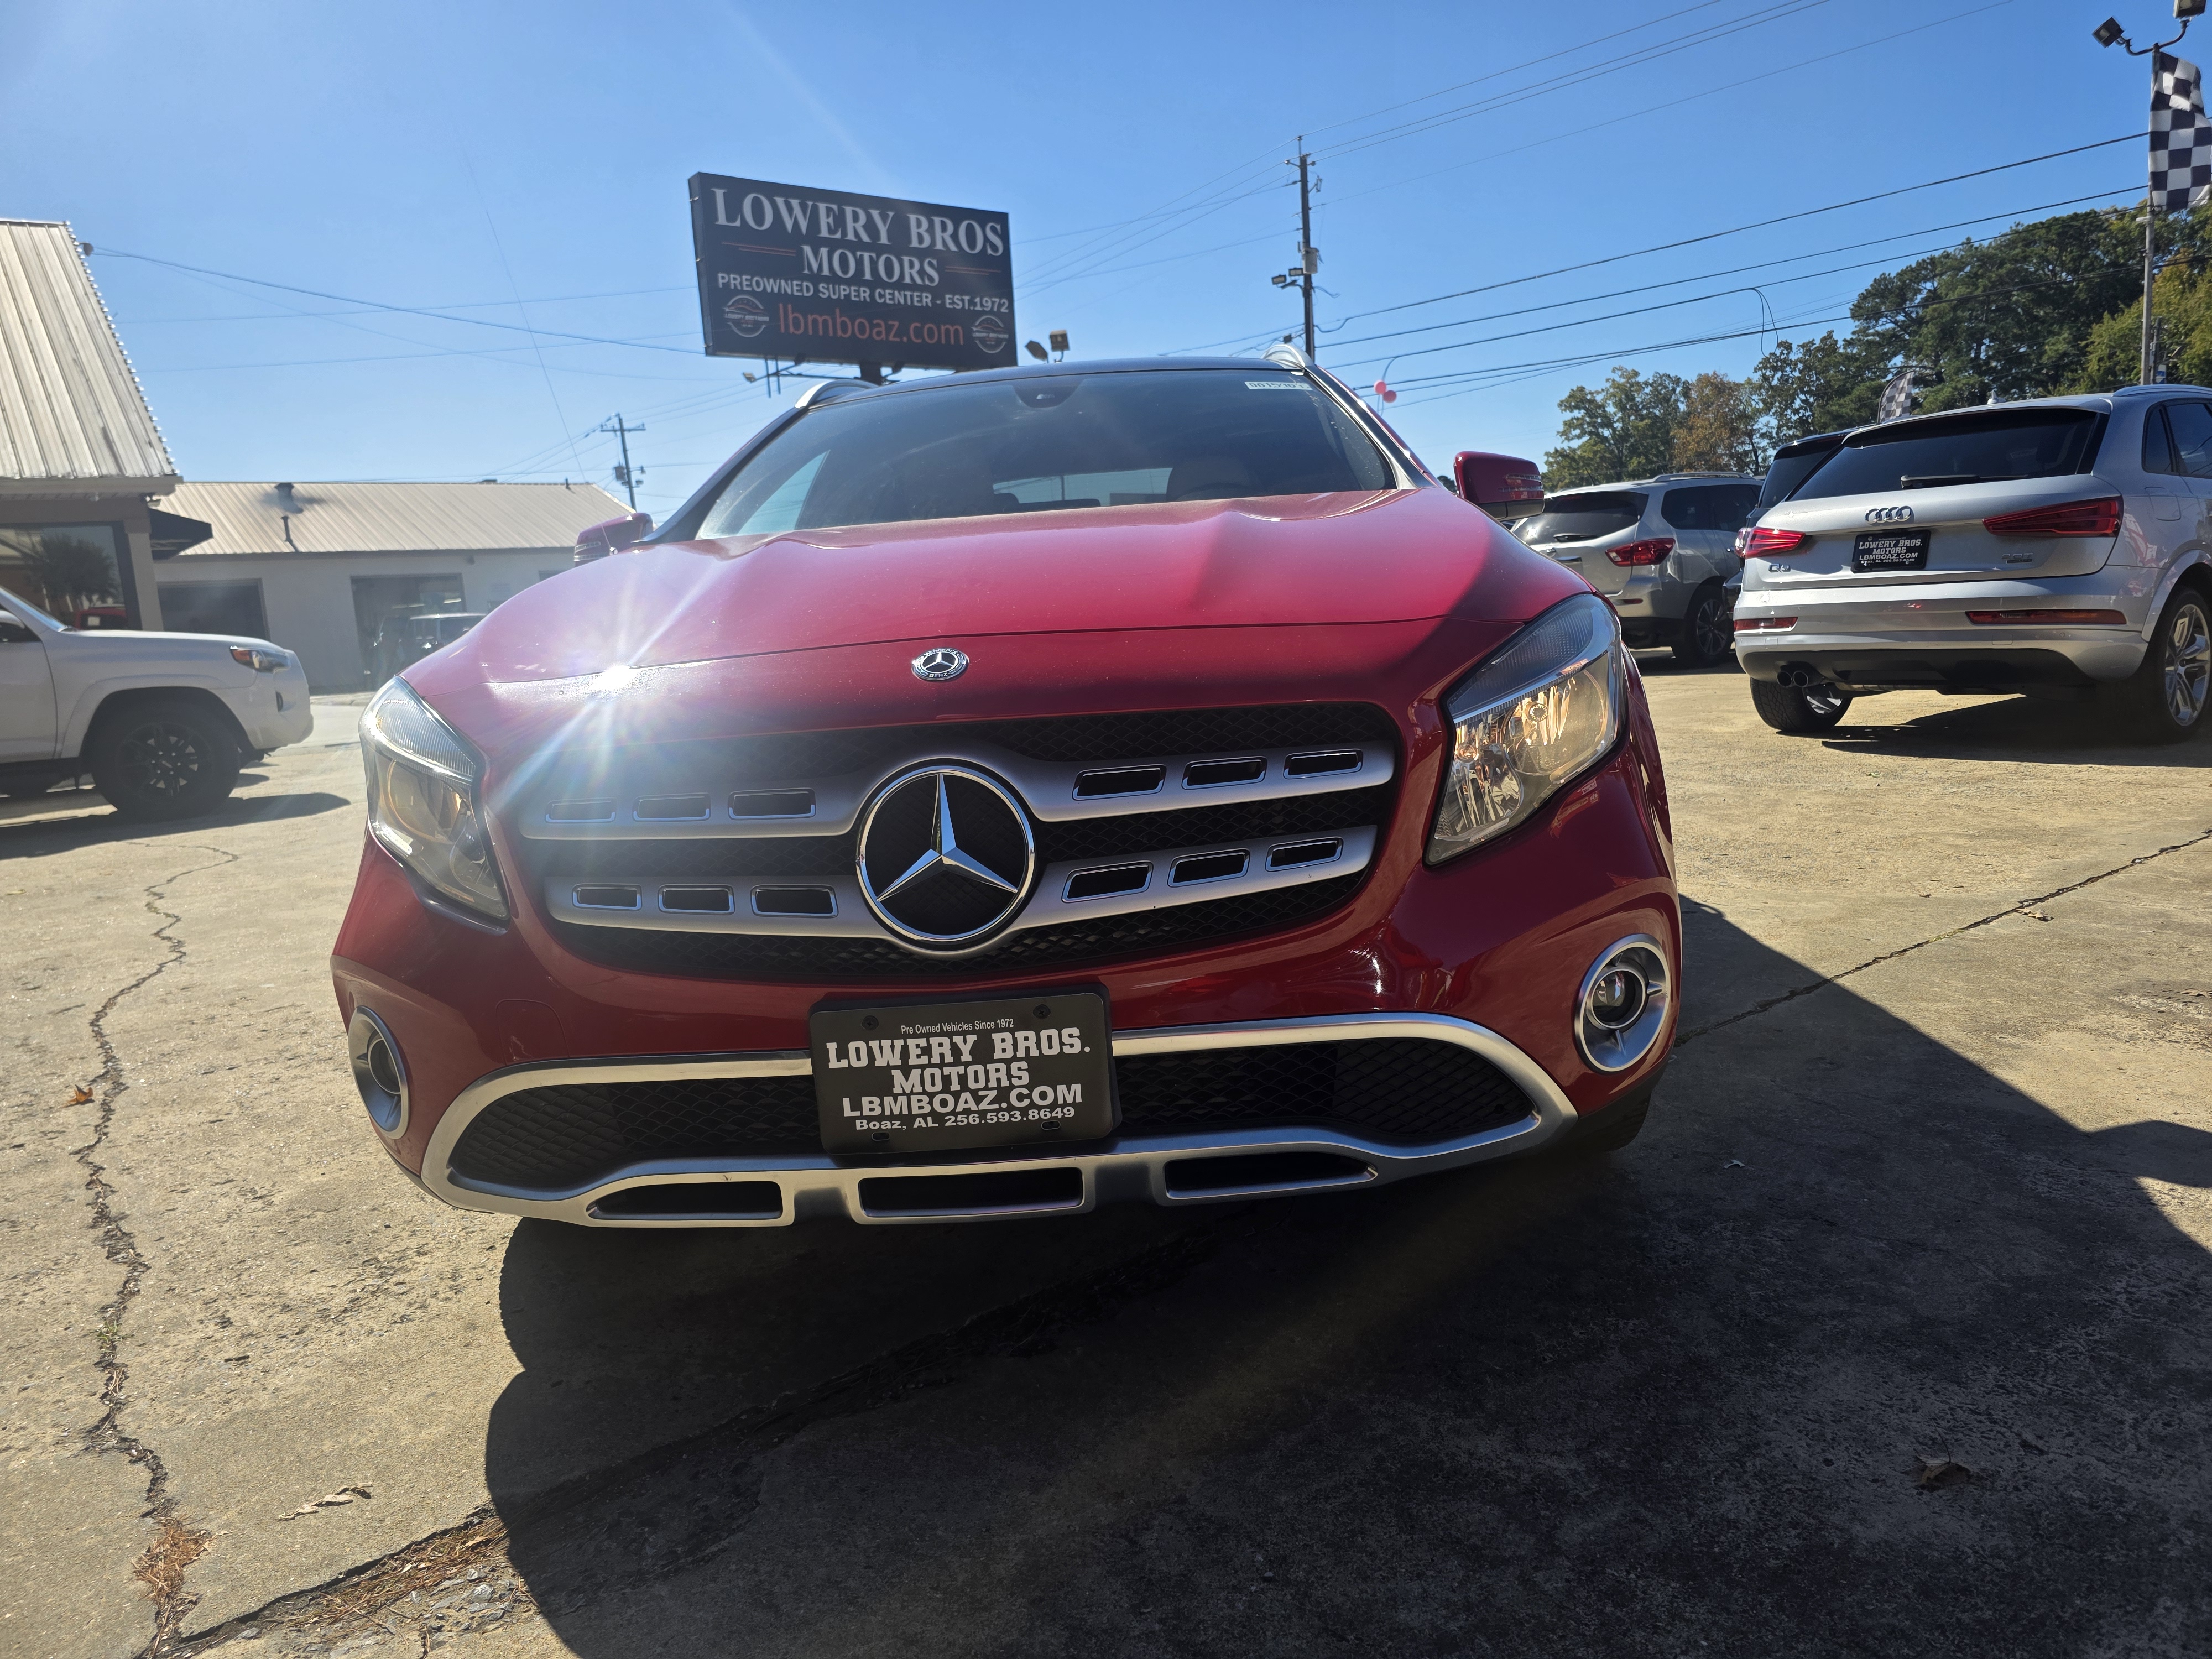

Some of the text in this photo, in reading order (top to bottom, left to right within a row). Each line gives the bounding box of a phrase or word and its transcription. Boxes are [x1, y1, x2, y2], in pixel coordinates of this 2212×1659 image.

[711, 188, 1004, 256] LOWERY BROS
[800, 244, 940, 286] MOTORS
[718, 273, 814, 297] PREOWNED
[818, 283, 870, 302] SUPER
[875, 289, 932, 307] CENTER
[946, 295, 1009, 313] EST.1972
[779, 302, 964, 346] lbmboaz.com
[901, 1018, 1014, 1034] Pre Owned Vehicles Since 1972
[826, 1027, 1091, 1068] LOWERY BROS.
[891, 1061, 1030, 1094] MOTORS
[843, 1083, 1083, 1117] LBMBOAZ.COM
[855, 1107, 1076, 1130] Boaz, AL 256.593.8649
